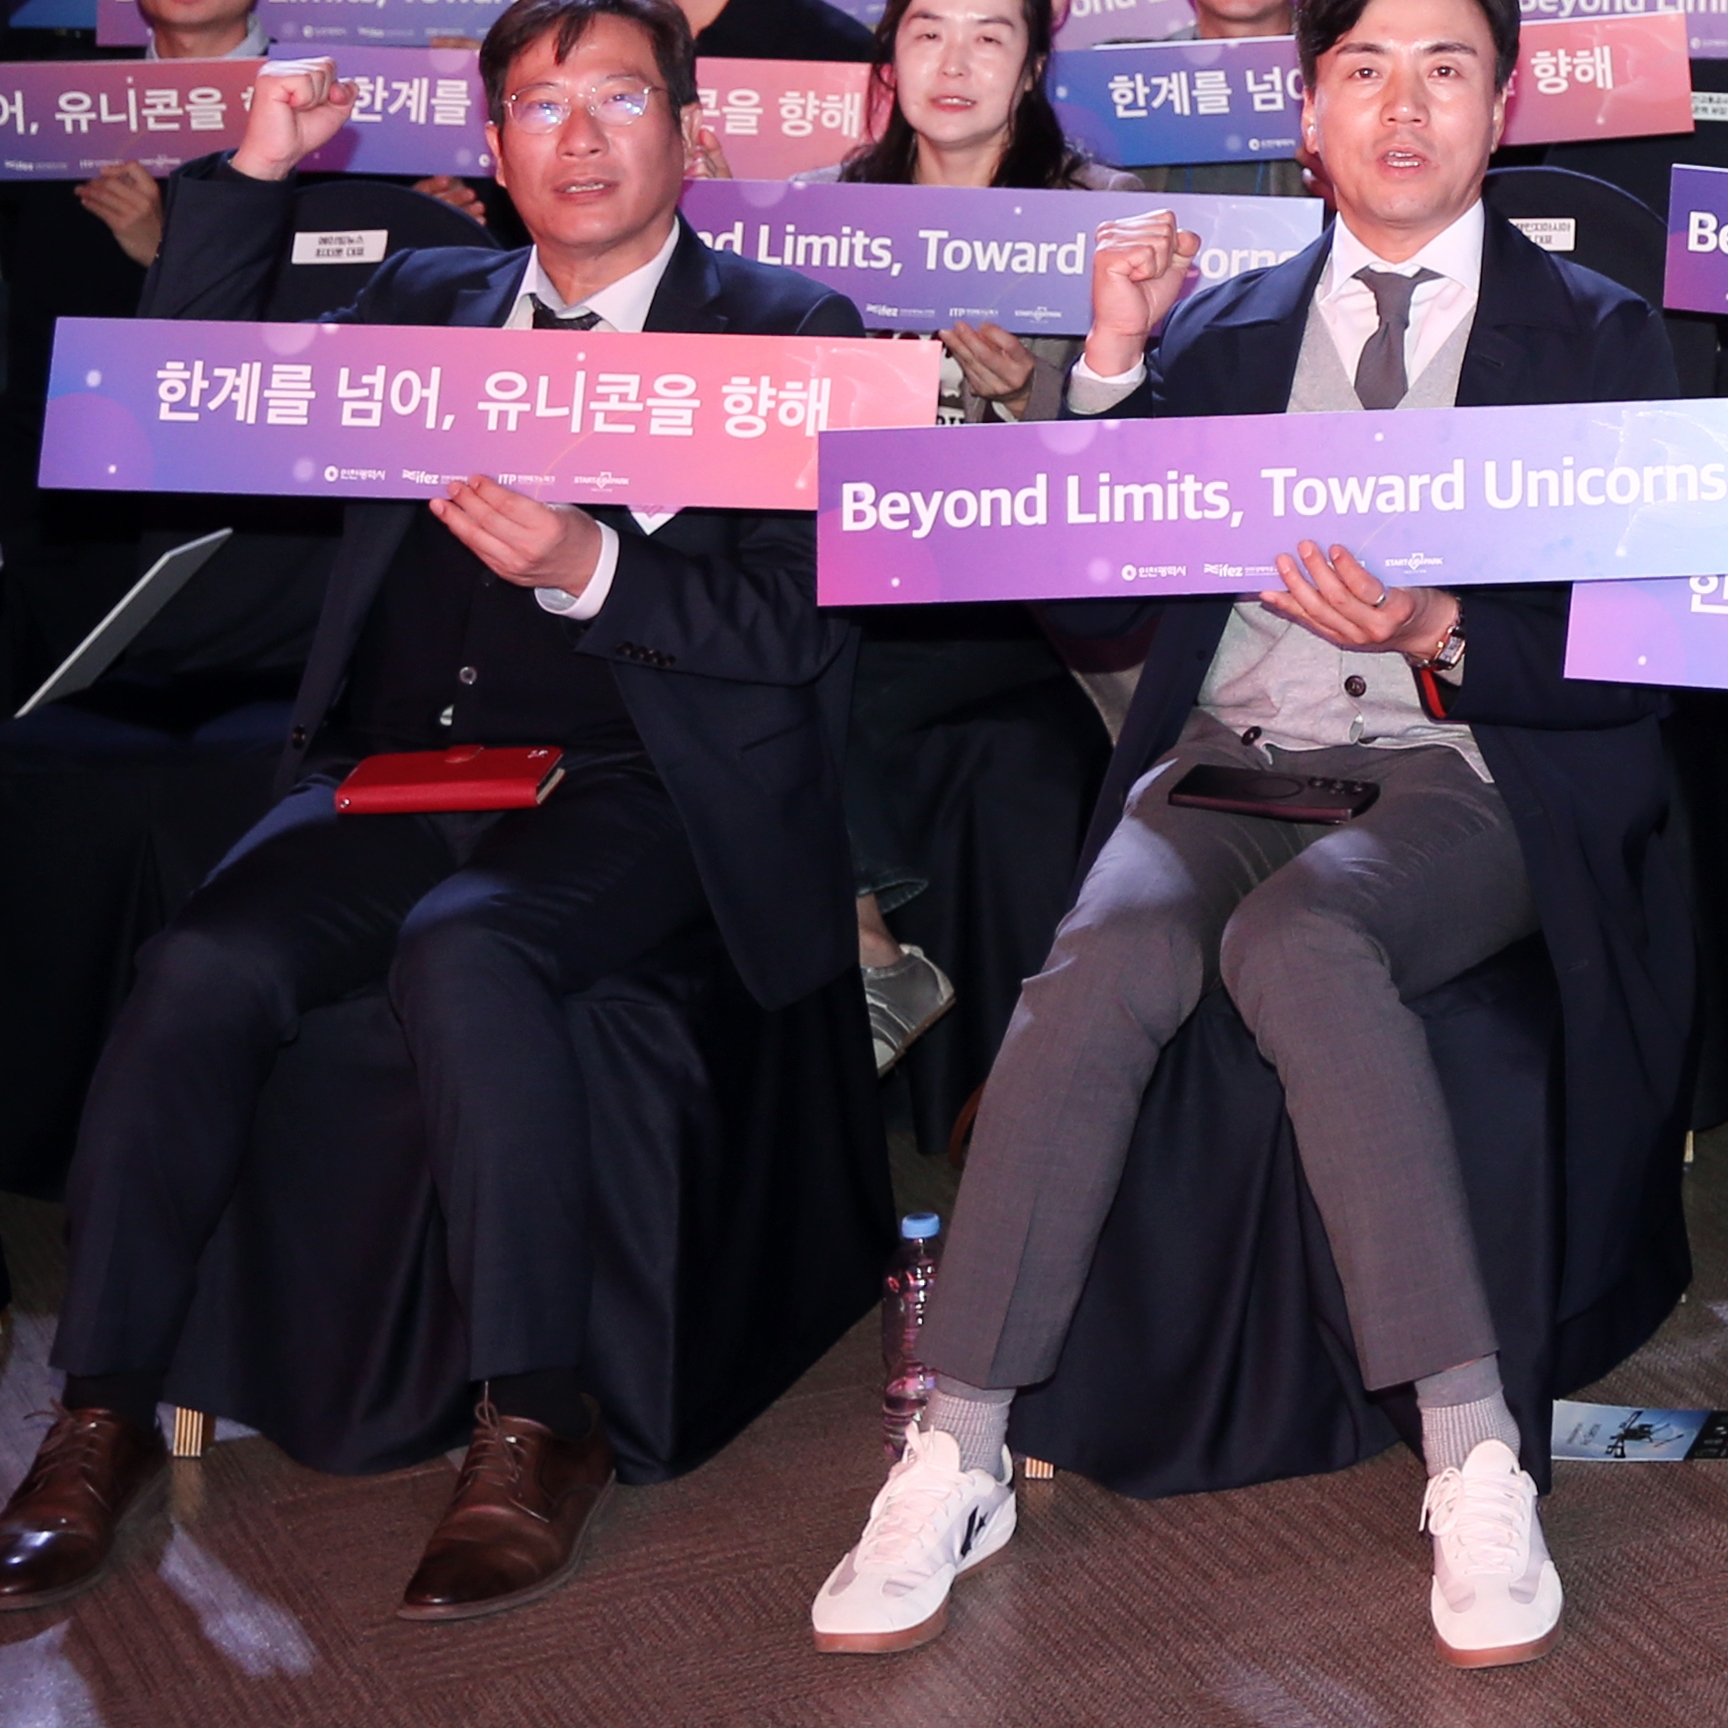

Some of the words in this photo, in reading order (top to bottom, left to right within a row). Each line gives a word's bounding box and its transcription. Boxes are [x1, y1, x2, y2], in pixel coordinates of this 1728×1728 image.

[1107, 70, 1233, 120] 한계를
[1531, 45, 1615, 95] 향해
[55, 80, 229, 135] 유니콘을
[778, 86, 864, 139] 향해
[756, 222, 904, 280] Limits,
[918, 227, 1087, 275] Toward
[156, 359, 318, 426] 한계를
[336, 365, 456, 432] 넘어,
[476, 364, 701, 438] 유니콘을
[720, 373, 831, 439] 향해
[498, 473, 517, 486] ITP
[840, 472, 1047, 539] Beyond
[1067, 466, 1246, 531] Limits,
[1260, 456, 1467, 519] Toward
[1485, 451, 1728, 511] Unicorns
